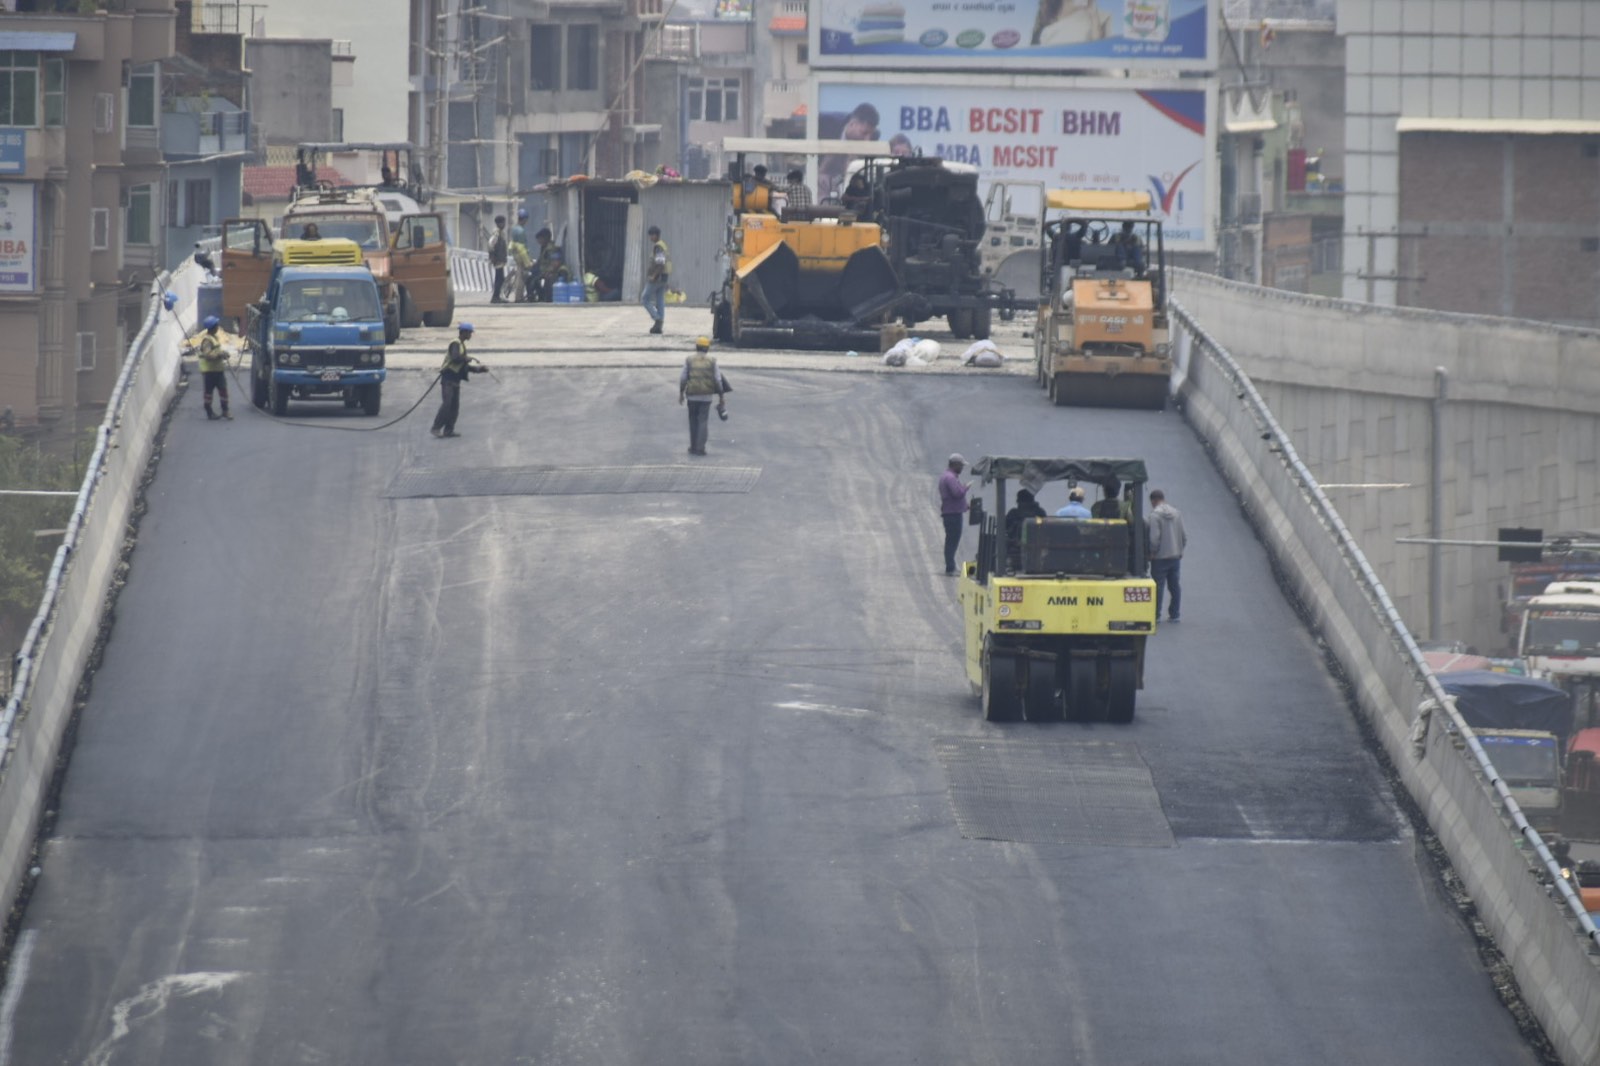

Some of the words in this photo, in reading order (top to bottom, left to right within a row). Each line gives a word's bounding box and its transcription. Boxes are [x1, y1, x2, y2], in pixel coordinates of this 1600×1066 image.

[900, 106, 951, 132] BBA
[969, 108, 1043, 134] BCSIT
[1062, 110, 1121, 136] BHM
[993, 145, 1058, 168] MCSIT
